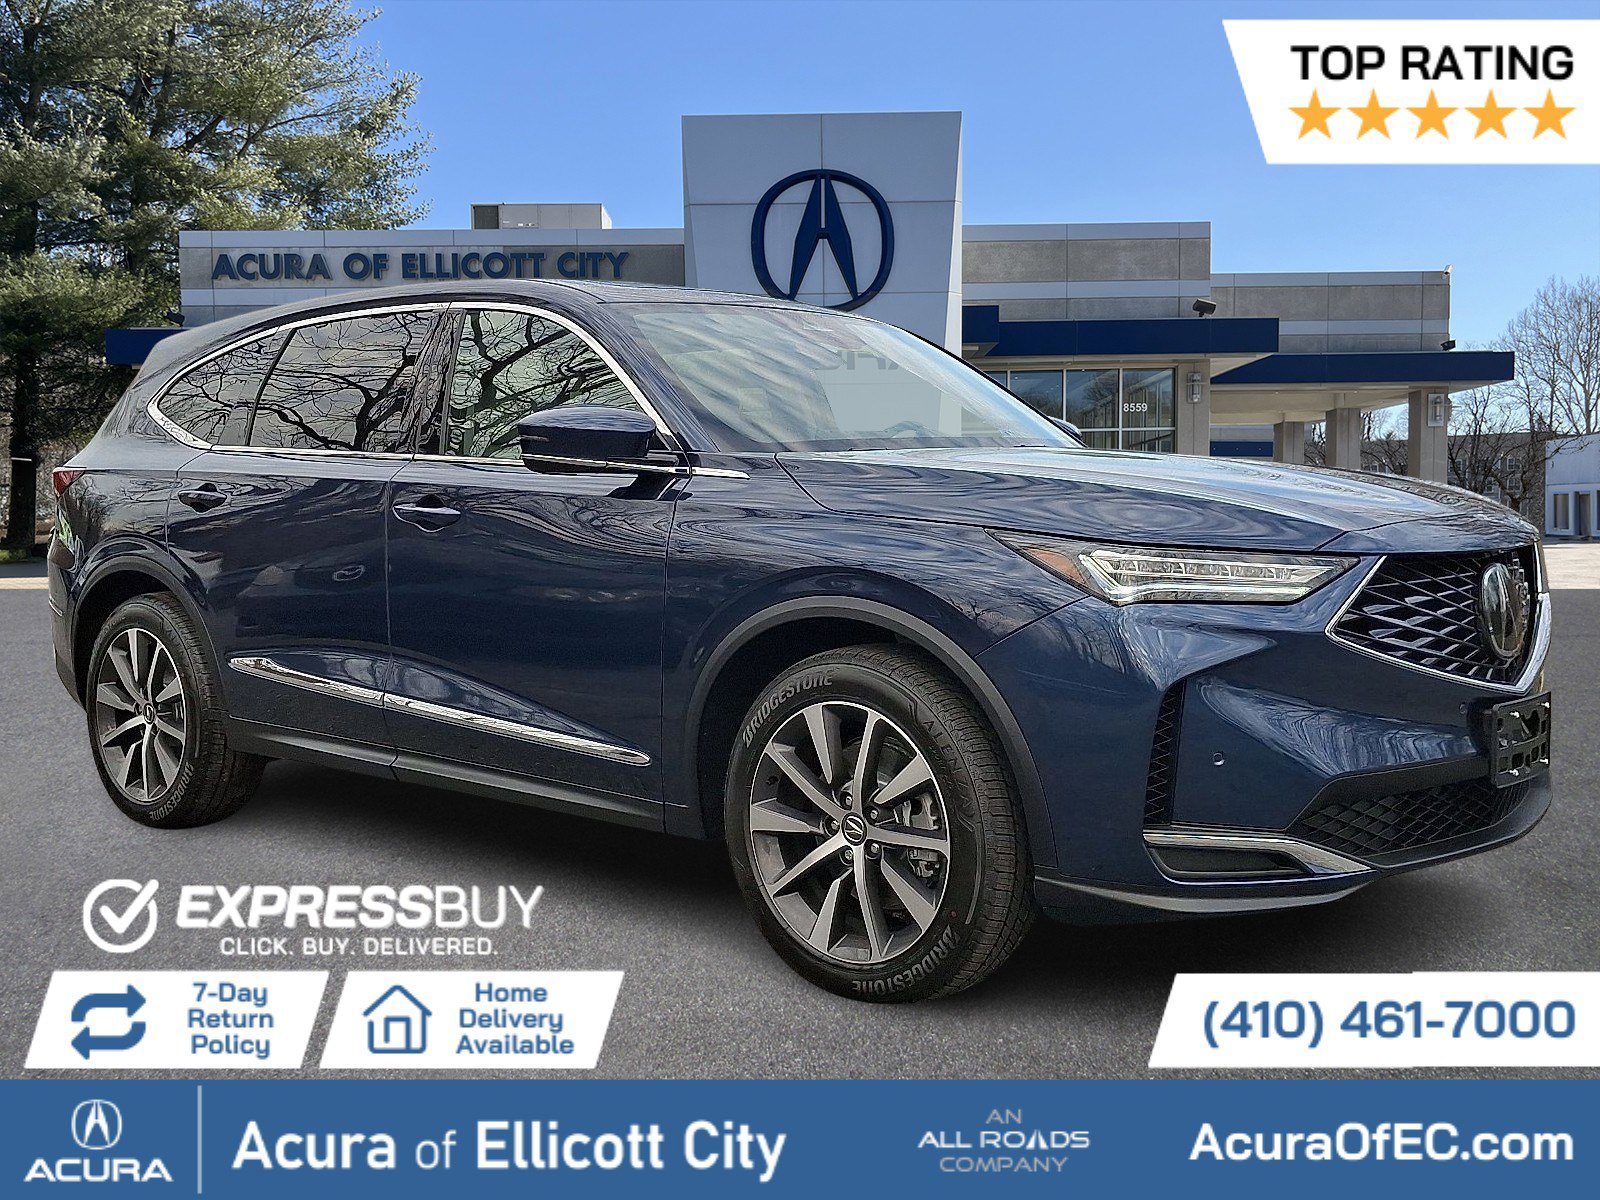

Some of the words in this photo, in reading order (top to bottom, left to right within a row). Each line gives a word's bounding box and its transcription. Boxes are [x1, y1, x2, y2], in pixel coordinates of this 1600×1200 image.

[212, 253, 333, 280] ACURA
[343, 252, 389, 280] OF
[401, 250, 546, 280] ELLICOTT
[557, 251, 630, 279] CITY
[1123, 402, 1148, 412] 8559
[742, 669, 834, 748] BRIDGESTONE
[149, 761, 194, 820] BRIDGESTONE
[852, 924, 962, 995] BRIDGESTONE
